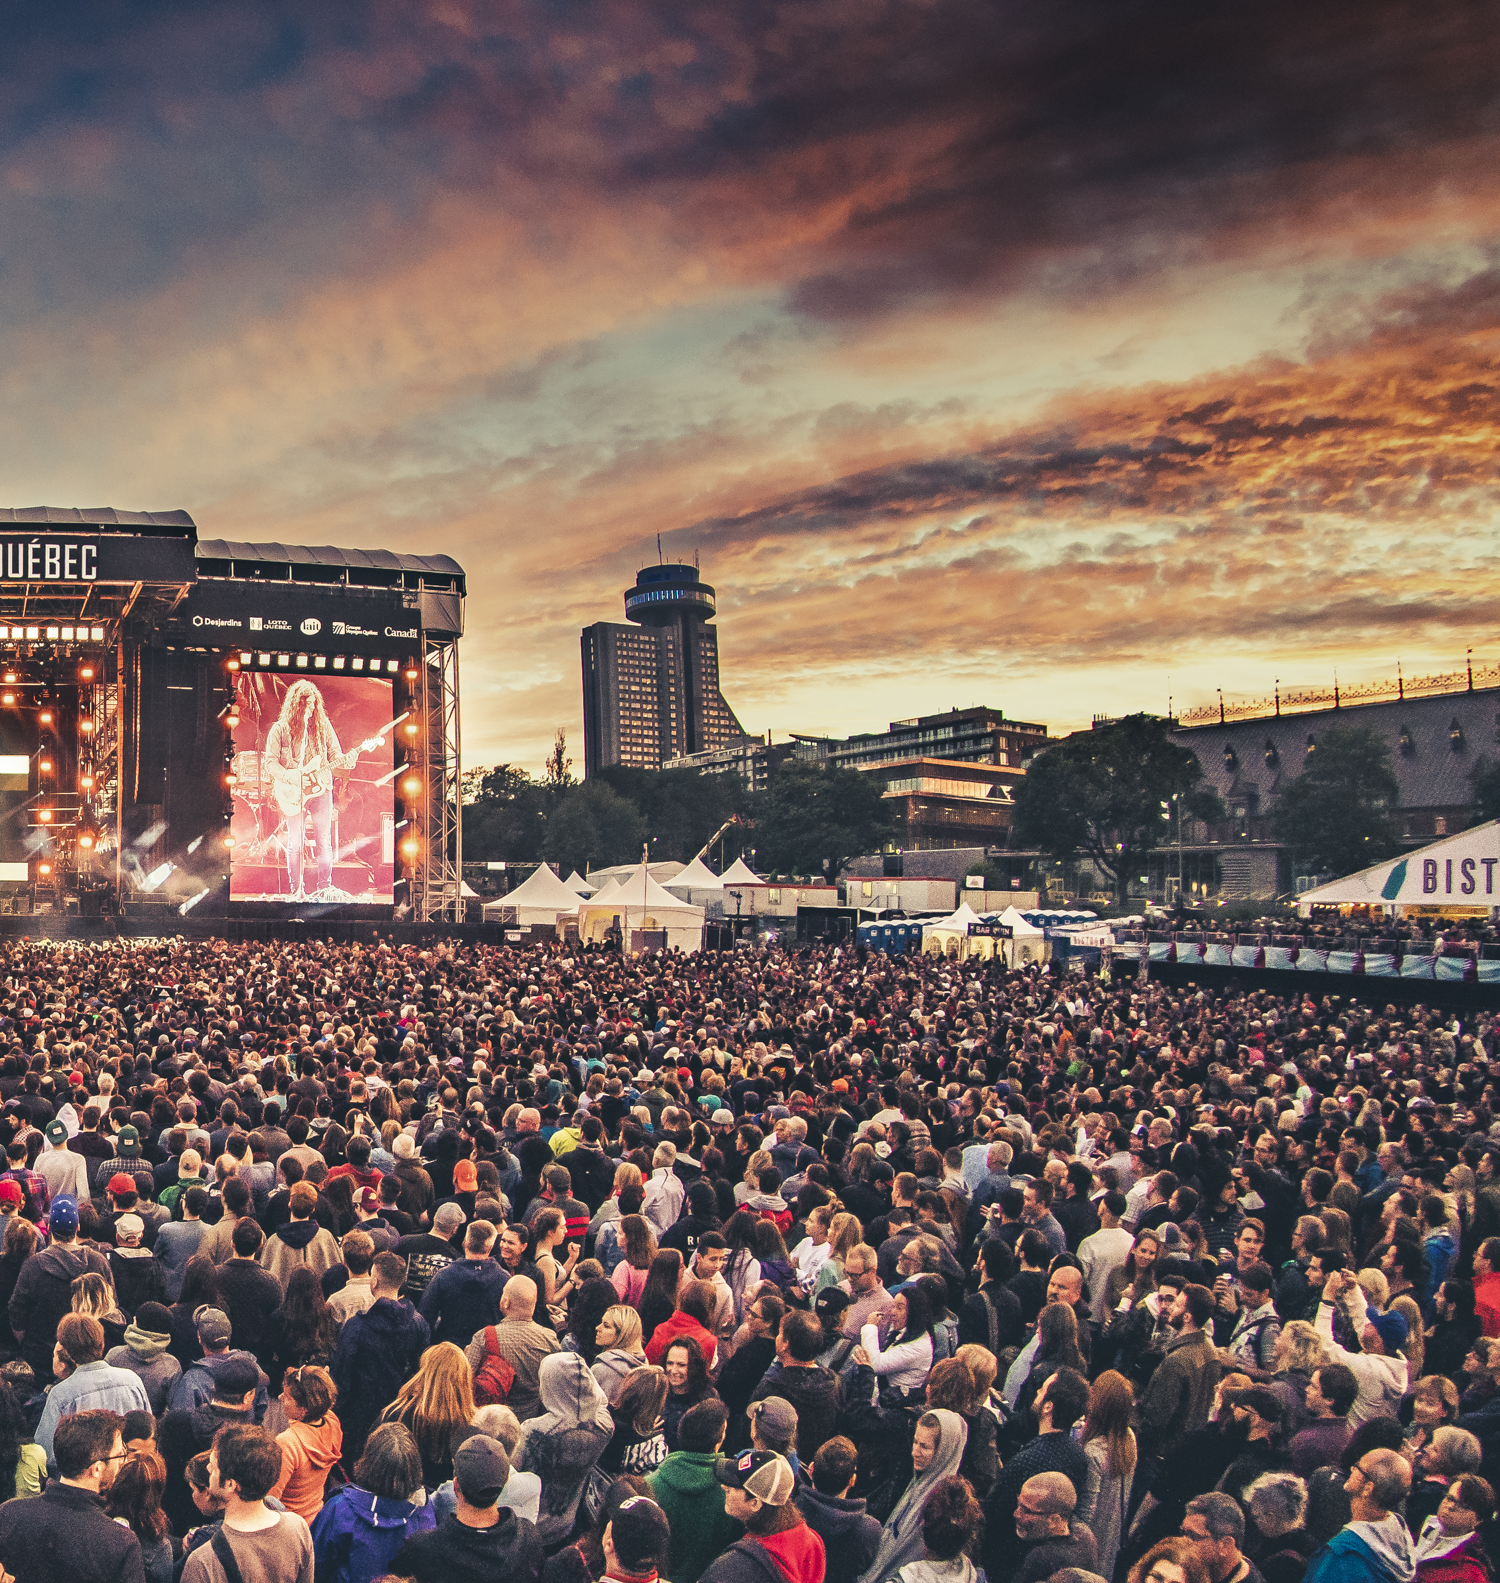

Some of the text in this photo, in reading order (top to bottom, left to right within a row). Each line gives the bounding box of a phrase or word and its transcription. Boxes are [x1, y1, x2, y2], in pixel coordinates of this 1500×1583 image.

[204, 617, 243, 627] Desjardins
[303, 621, 319, 631] lait
[384, 626, 418, 639] Canada
[1423, 858, 1498, 895] BIST
[976, 926, 990, 934] BAR
